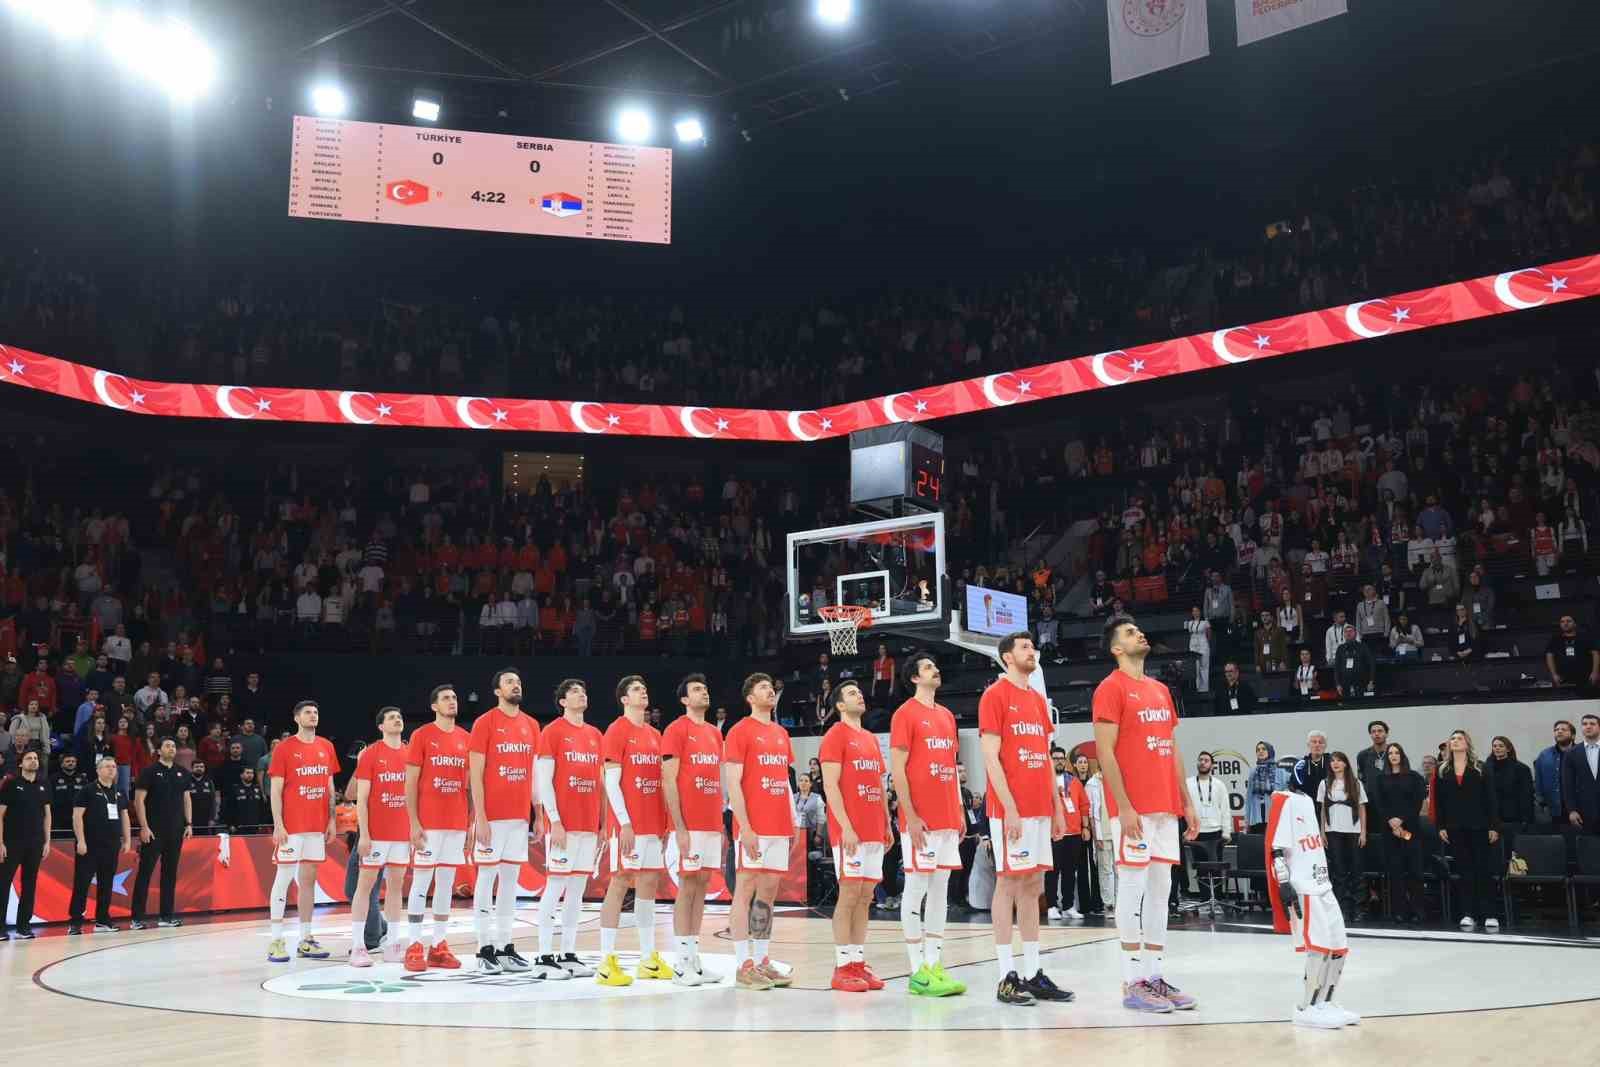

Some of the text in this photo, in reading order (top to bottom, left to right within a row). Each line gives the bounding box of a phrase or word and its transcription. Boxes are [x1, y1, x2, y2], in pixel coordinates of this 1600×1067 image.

[416, 132, 462, 144] TÜRKİYE
[516, 141, 554, 151] SERBIA
[433, 152, 444, 166] 0
[530, 160, 540, 173] 0
[471, 190, 505, 204] 4:22
[917, 469, 940, 501] 24
